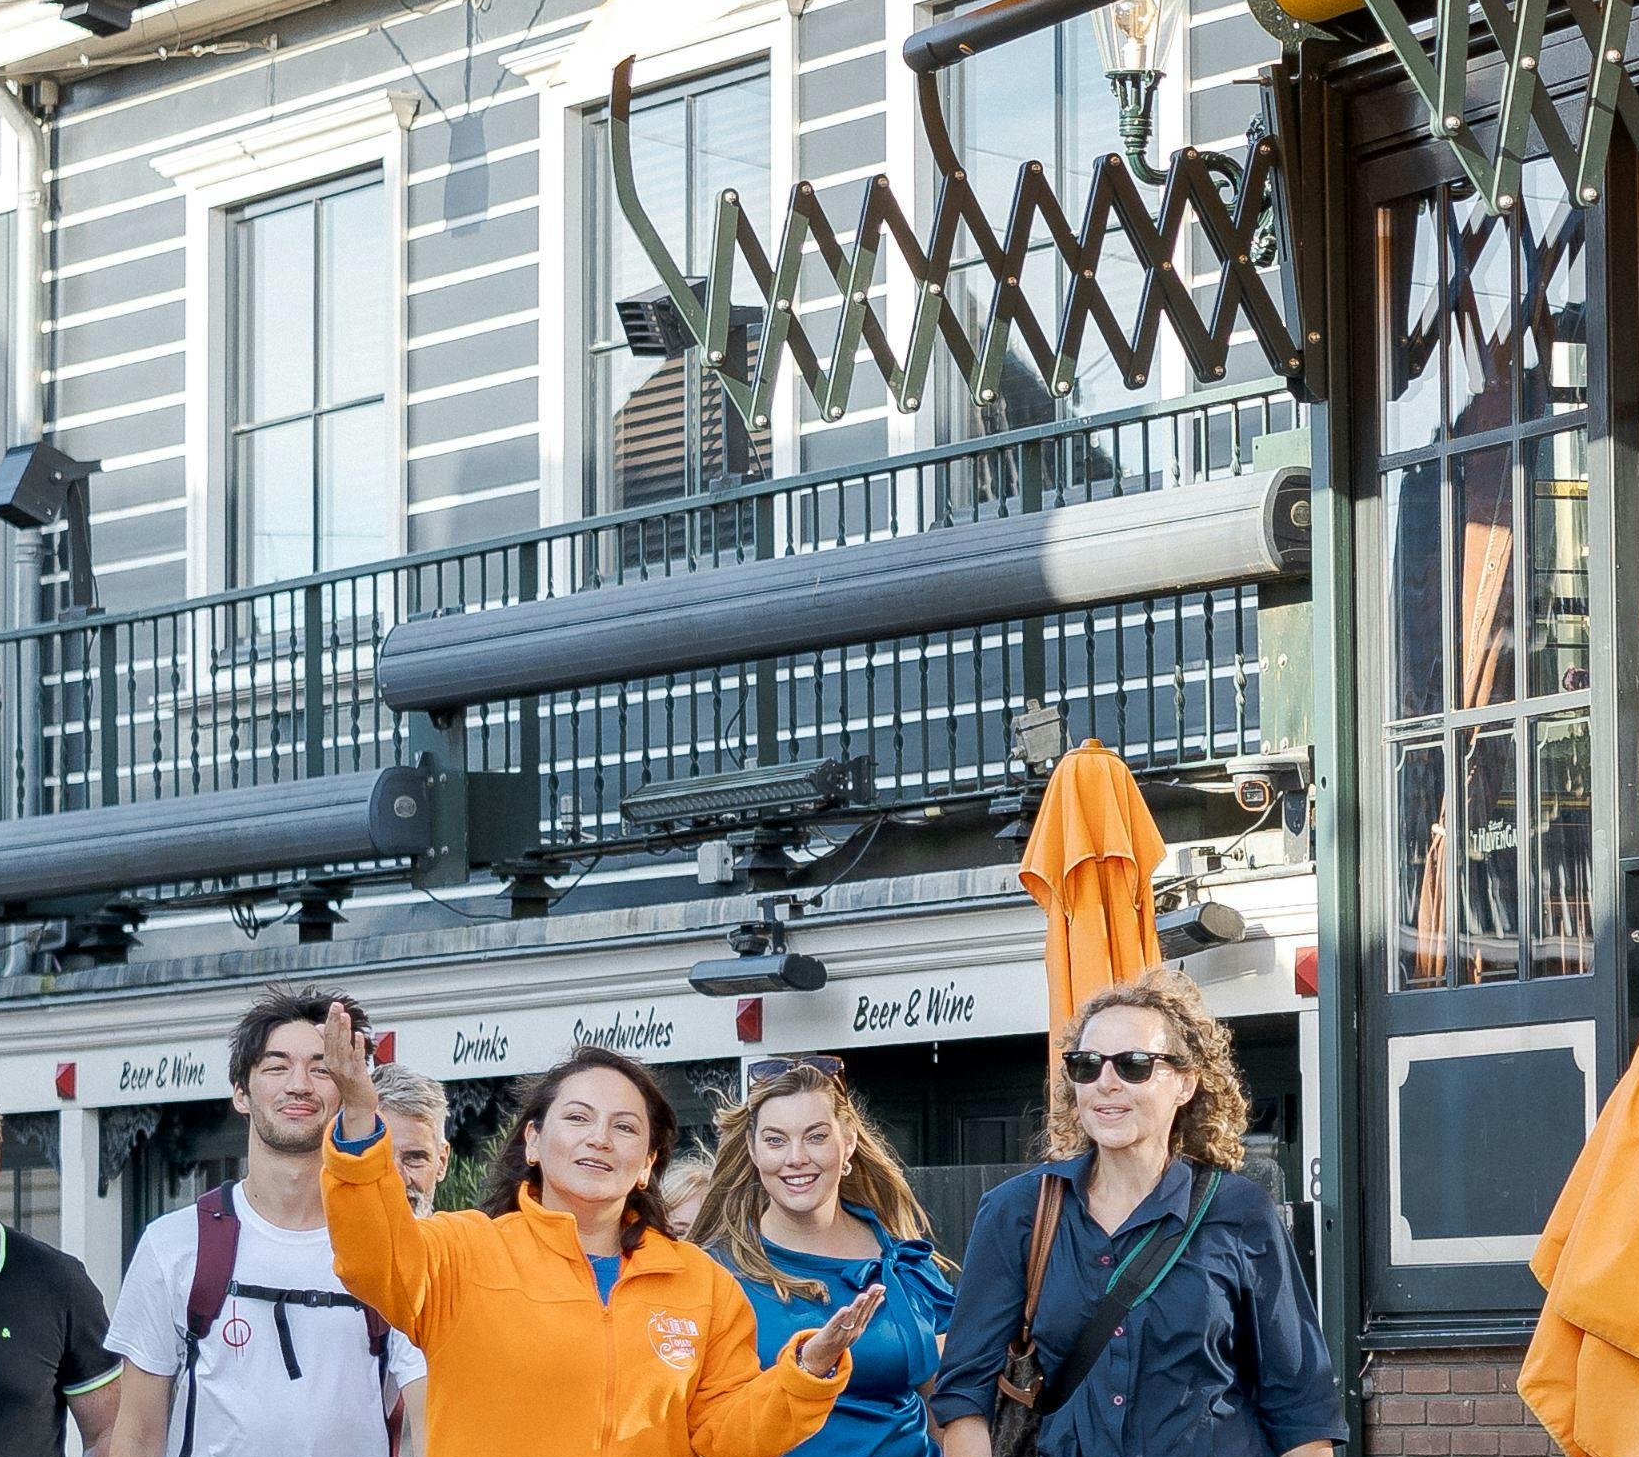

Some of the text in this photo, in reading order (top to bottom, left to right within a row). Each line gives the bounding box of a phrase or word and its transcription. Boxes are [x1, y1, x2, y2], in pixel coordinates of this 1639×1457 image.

[1478, 824, 1518, 853] HAVENGA
[852, 987, 976, 1033] Beer & Wine
[452, 1005, 674, 1064] Drinks Sandwiches
[119, 1051, 206, 1091] Beer & Wine
